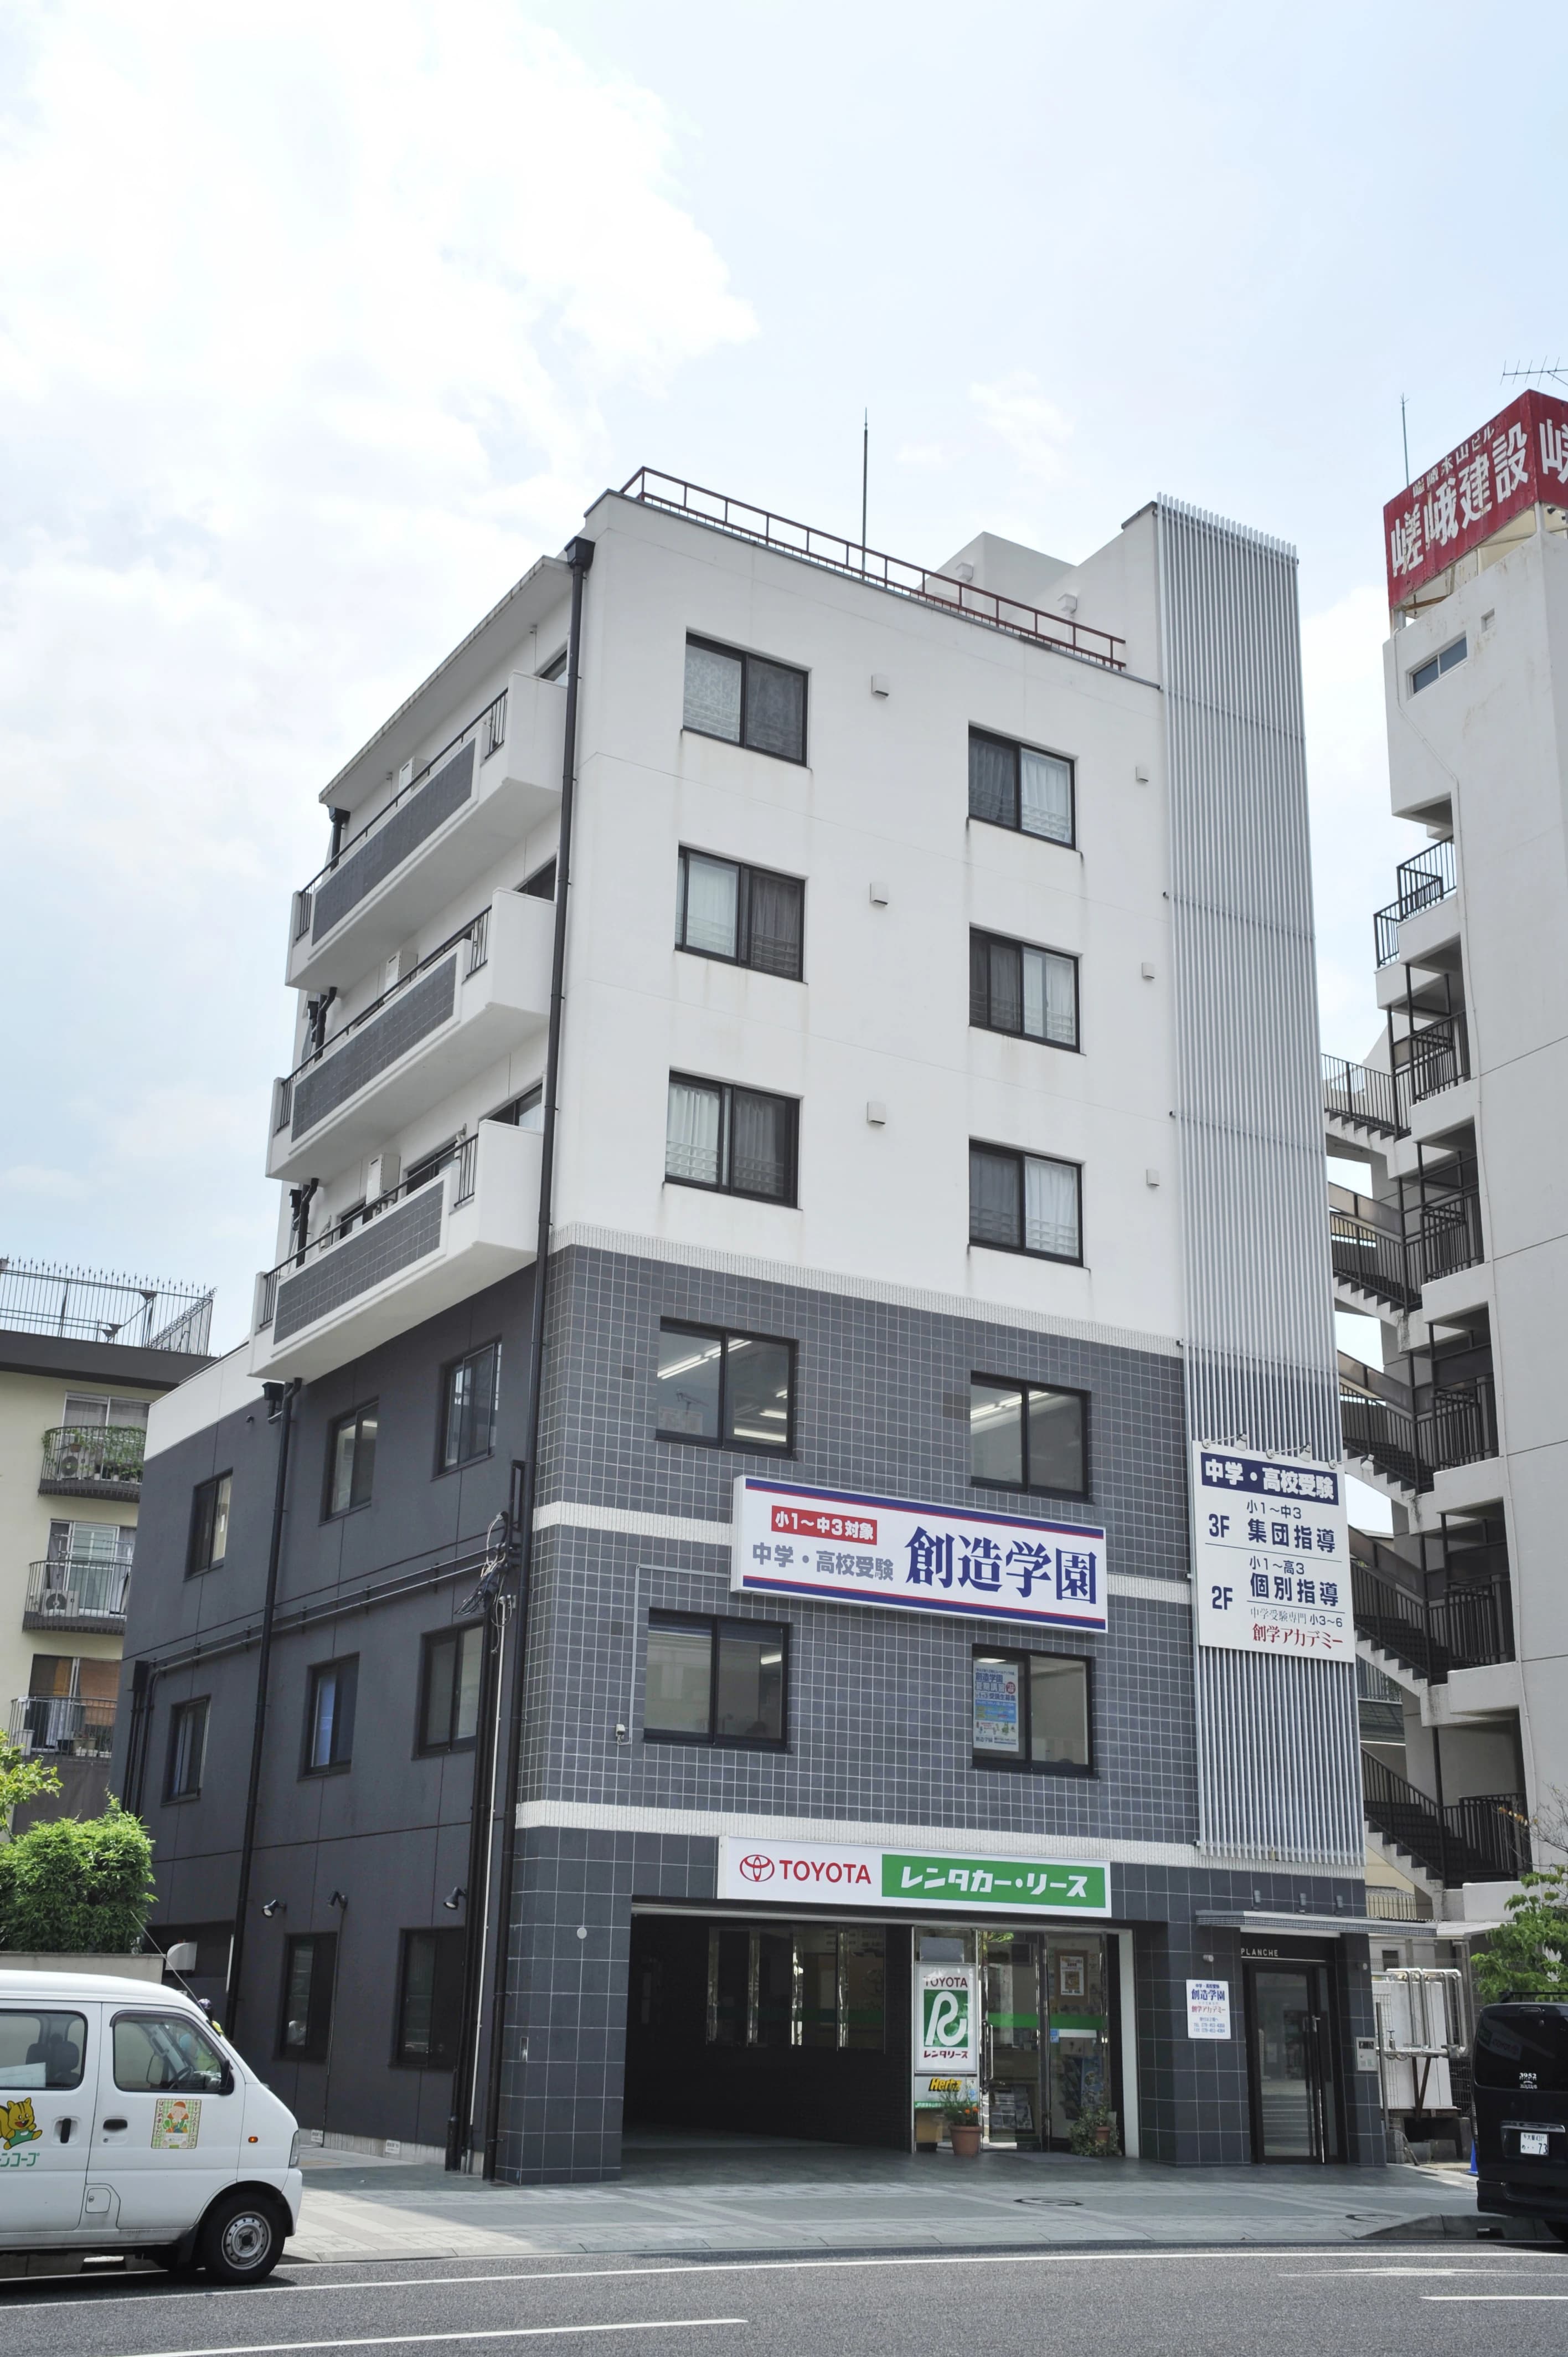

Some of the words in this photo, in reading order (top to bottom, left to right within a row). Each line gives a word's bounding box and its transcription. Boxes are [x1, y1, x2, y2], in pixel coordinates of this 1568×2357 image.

[1390, 422, 1527, 578] 嵯峨建設
[1205, 1459, 1334, 1500] 中学・高校受験
[1209, 1514, 1230, 1538] 3F
[1247, 1518, 1335, 1553] 集団指導
[752, 1542, 894, 1581] 中学・高校受験
[905, 1526, 1097, 1605] 創造学園
[1211, 1586, 1233, 1610] 2F
[1250, 1572, 1339, 1607] 個別指導
[1251, 1607, 1307, 1624] 中学受験専門
[1252, 1623, 1343, 1649] 創学アカデミー
[780, 1859, 871, 1885] TOYOTA
[901, 1866, 1088, 1898] レンタカー・リース
[1241, 1948, 1278, 1957] PLANCHE
[924, 2050, 968, 2059] レンタリース
[929, 2078, 962, 2092] Hertz
[0, 2153, 40, 2167] ンコープ
